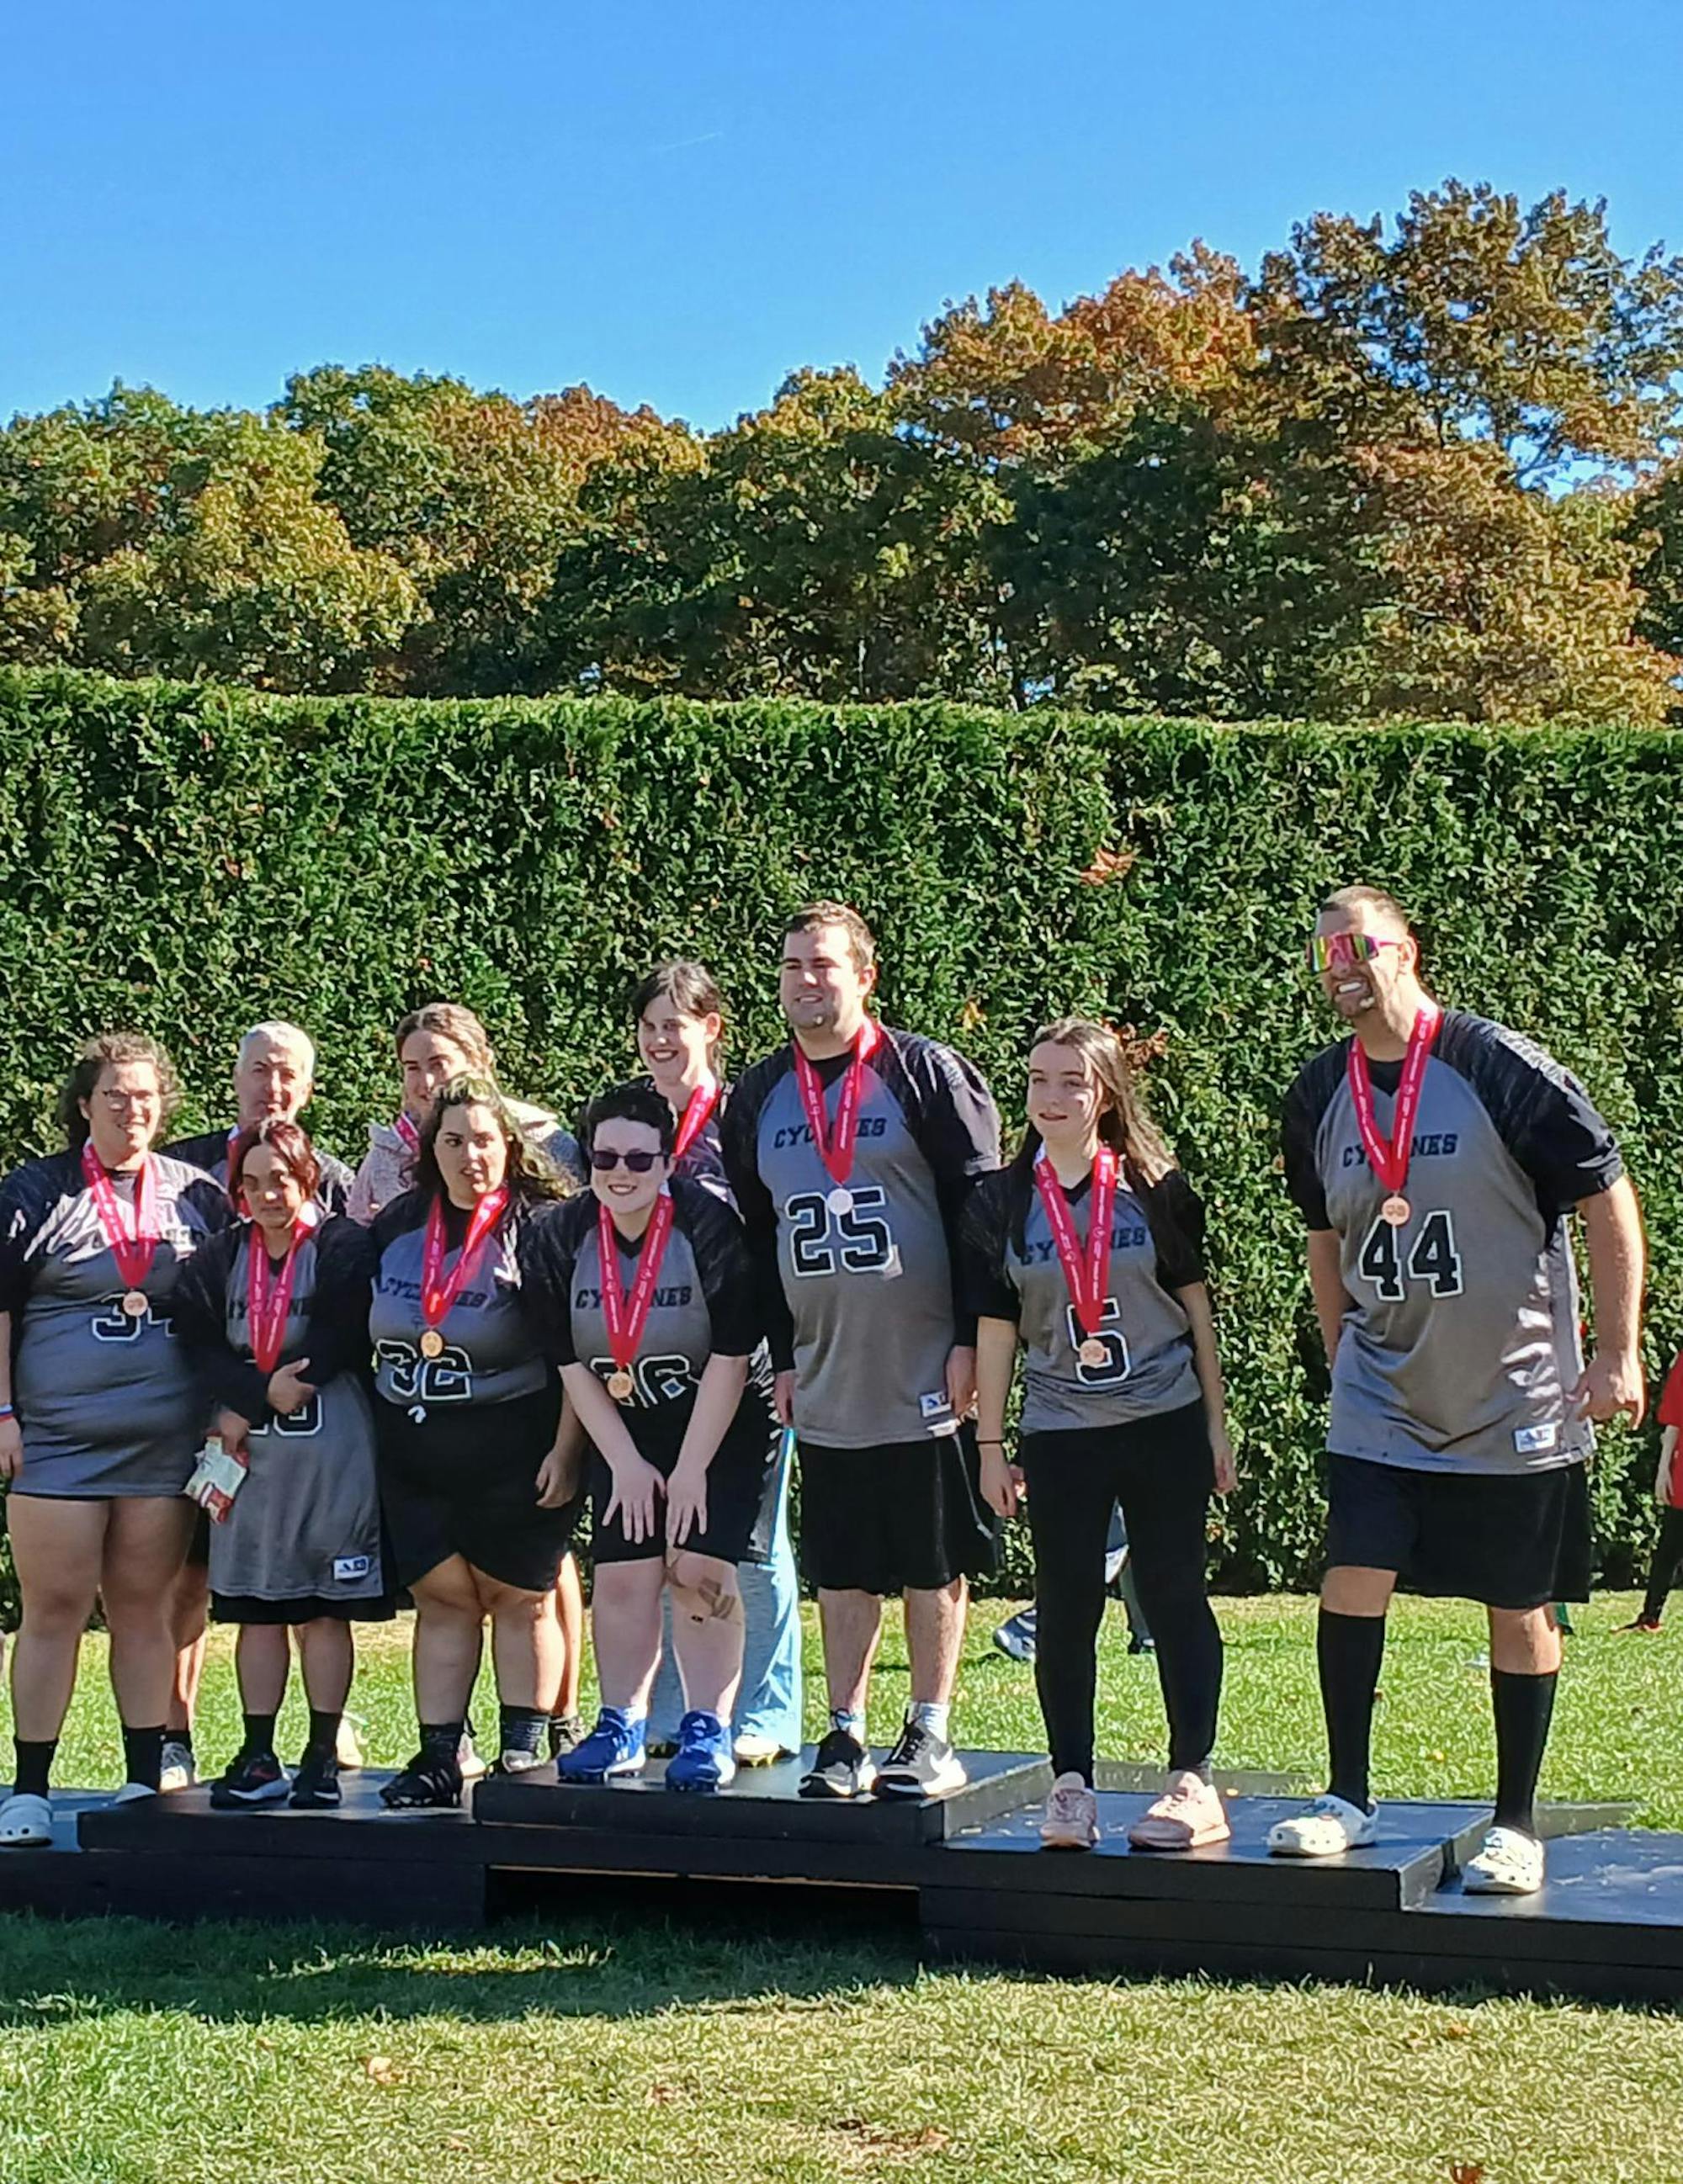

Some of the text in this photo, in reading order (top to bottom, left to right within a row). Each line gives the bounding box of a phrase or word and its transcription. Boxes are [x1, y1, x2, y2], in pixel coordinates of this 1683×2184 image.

[774, 1116, 887, 1148] CYCES
[1342, 1133, 1458, 1168] CYNES
[785, 1185, 894, 1276] 25
[1020, 1227, 1146, 1266] CYES
[1358, 1210, 1464, 1301] 44
[576, 1285, 693, 1309] CYNES
[1067, 1297, 1132, 1385] 5
